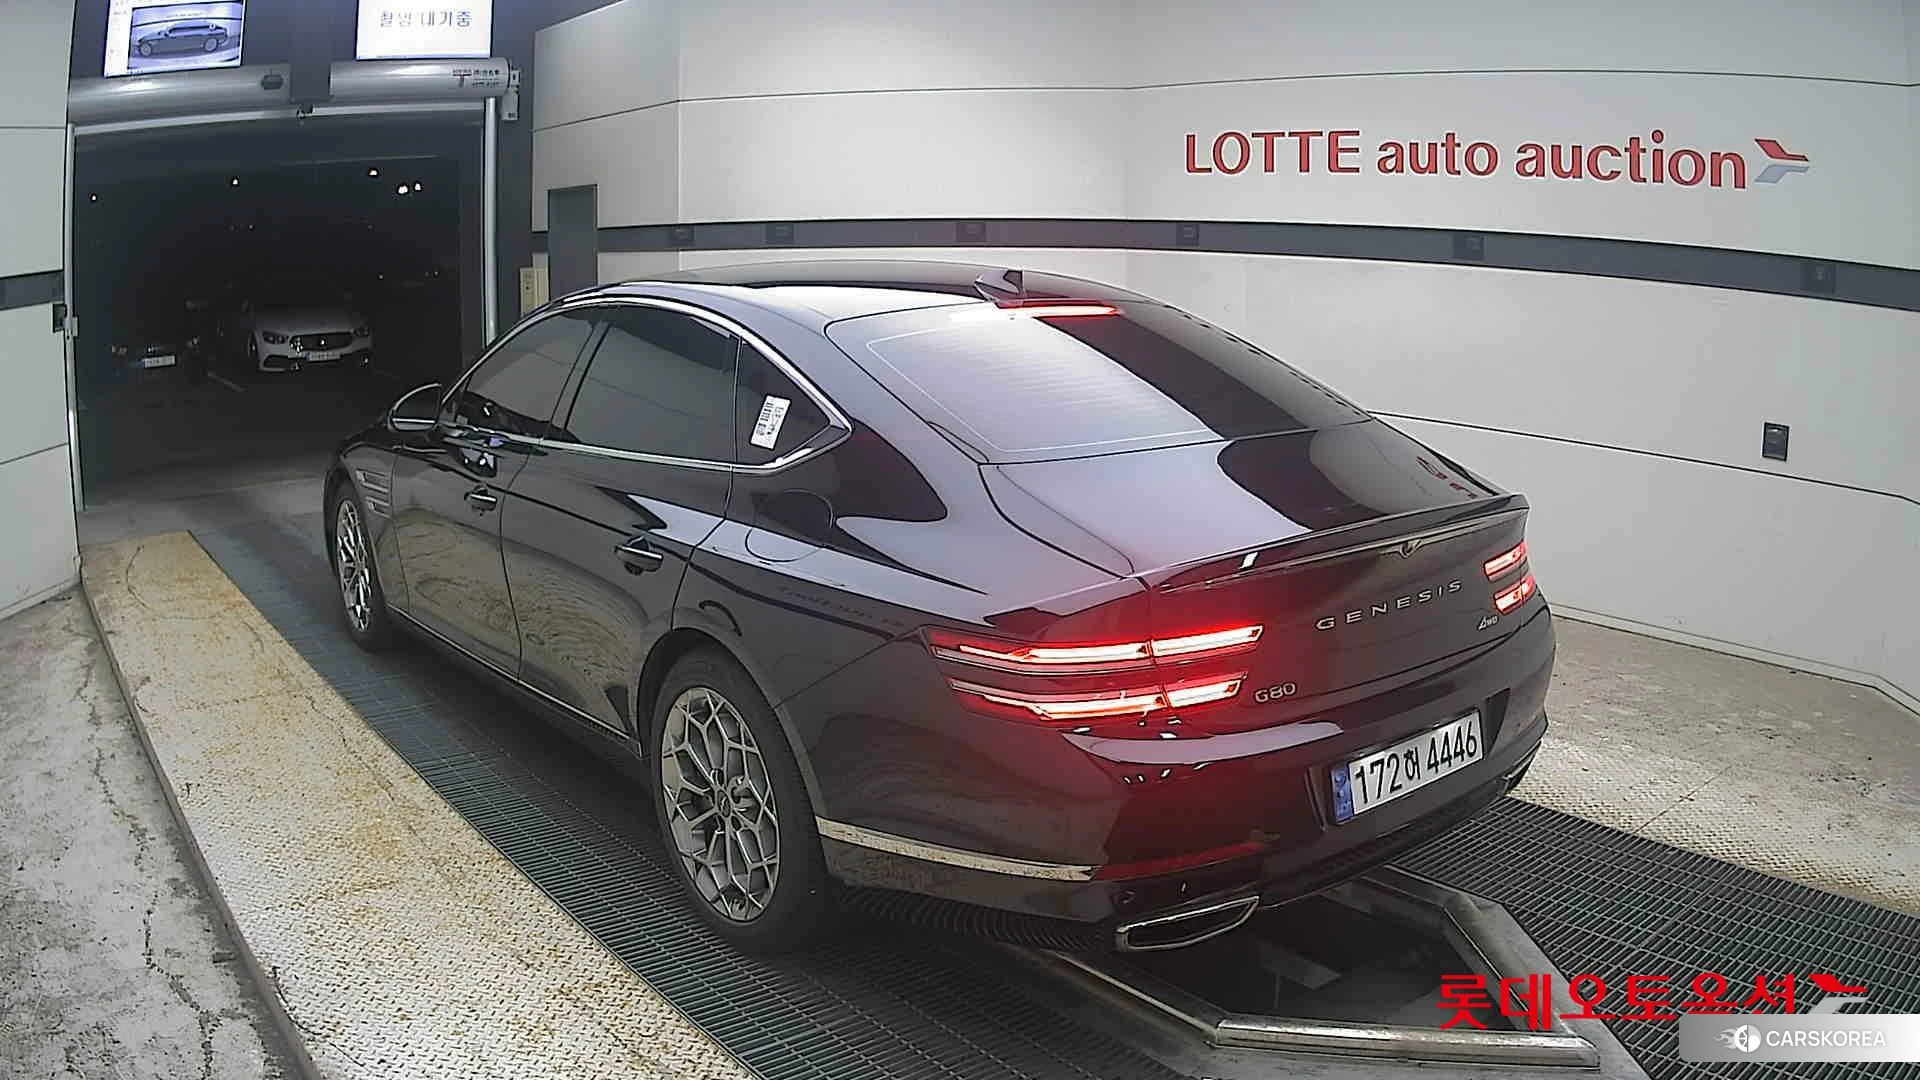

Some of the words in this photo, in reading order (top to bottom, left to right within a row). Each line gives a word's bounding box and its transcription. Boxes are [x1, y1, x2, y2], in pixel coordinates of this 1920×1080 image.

[1185, 130, 1361, 175] LOTTE
[1376, 131, 1499, 177] auto
[1514, 129, 1747, 190] auction
[1315, 579, 1464, 630] GENESIS
[1255, 682, 1297, 703] G80
[1354, 746, 1421, 805] 172허
[1427, 721, 1478, 774] 4446
